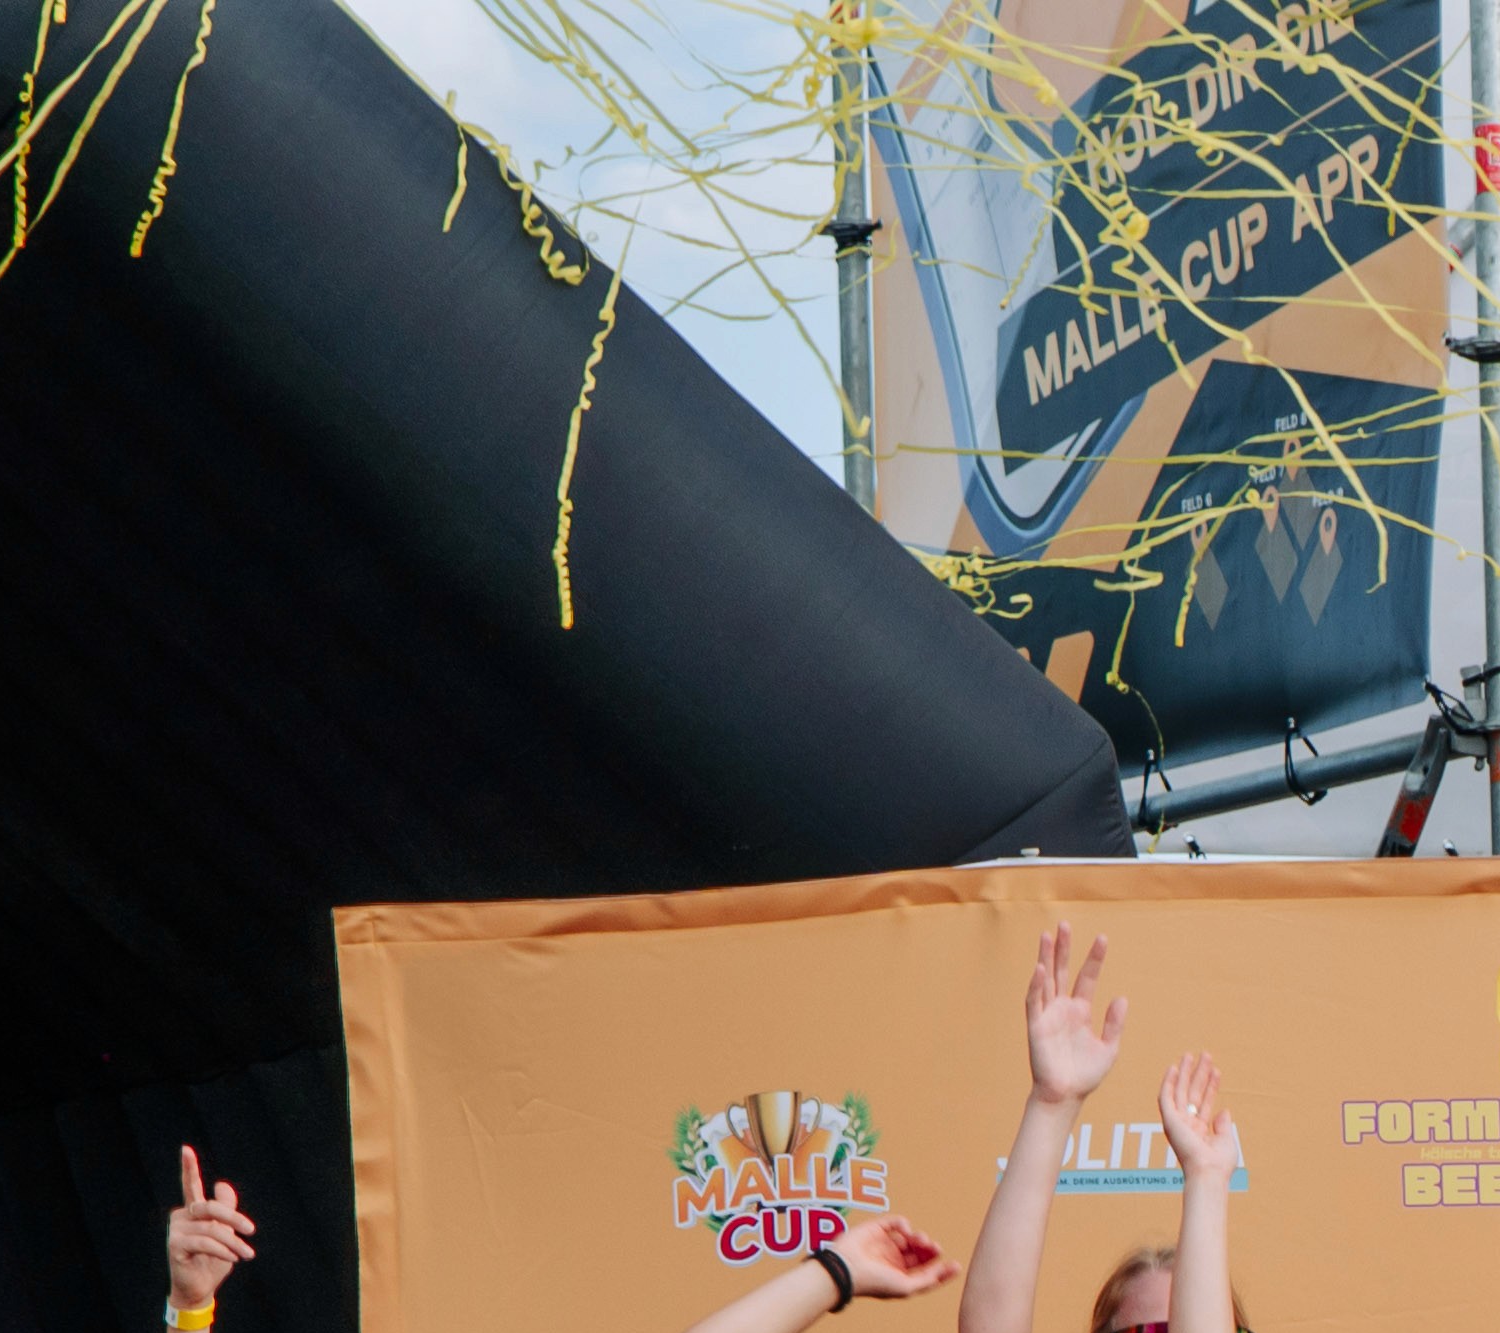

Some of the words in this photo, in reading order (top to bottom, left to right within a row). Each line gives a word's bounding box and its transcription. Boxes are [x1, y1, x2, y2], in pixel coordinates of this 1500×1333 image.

[1187, 34, 1260, 130] DIR
[1023, 268, 1167, 406] MALLE
[1181, 202, 1268, 303] CUP
[1291, 134, 1380, 243] APP
[1275, 413, 1298, 432] FELD
[1181, 494, 1203, 513] FELD
[674, 1154, 889, 1229] MALLE
[1073, 1177, 1100, 1186] DEINE
[716, 1206, 848, 1266] CUP
